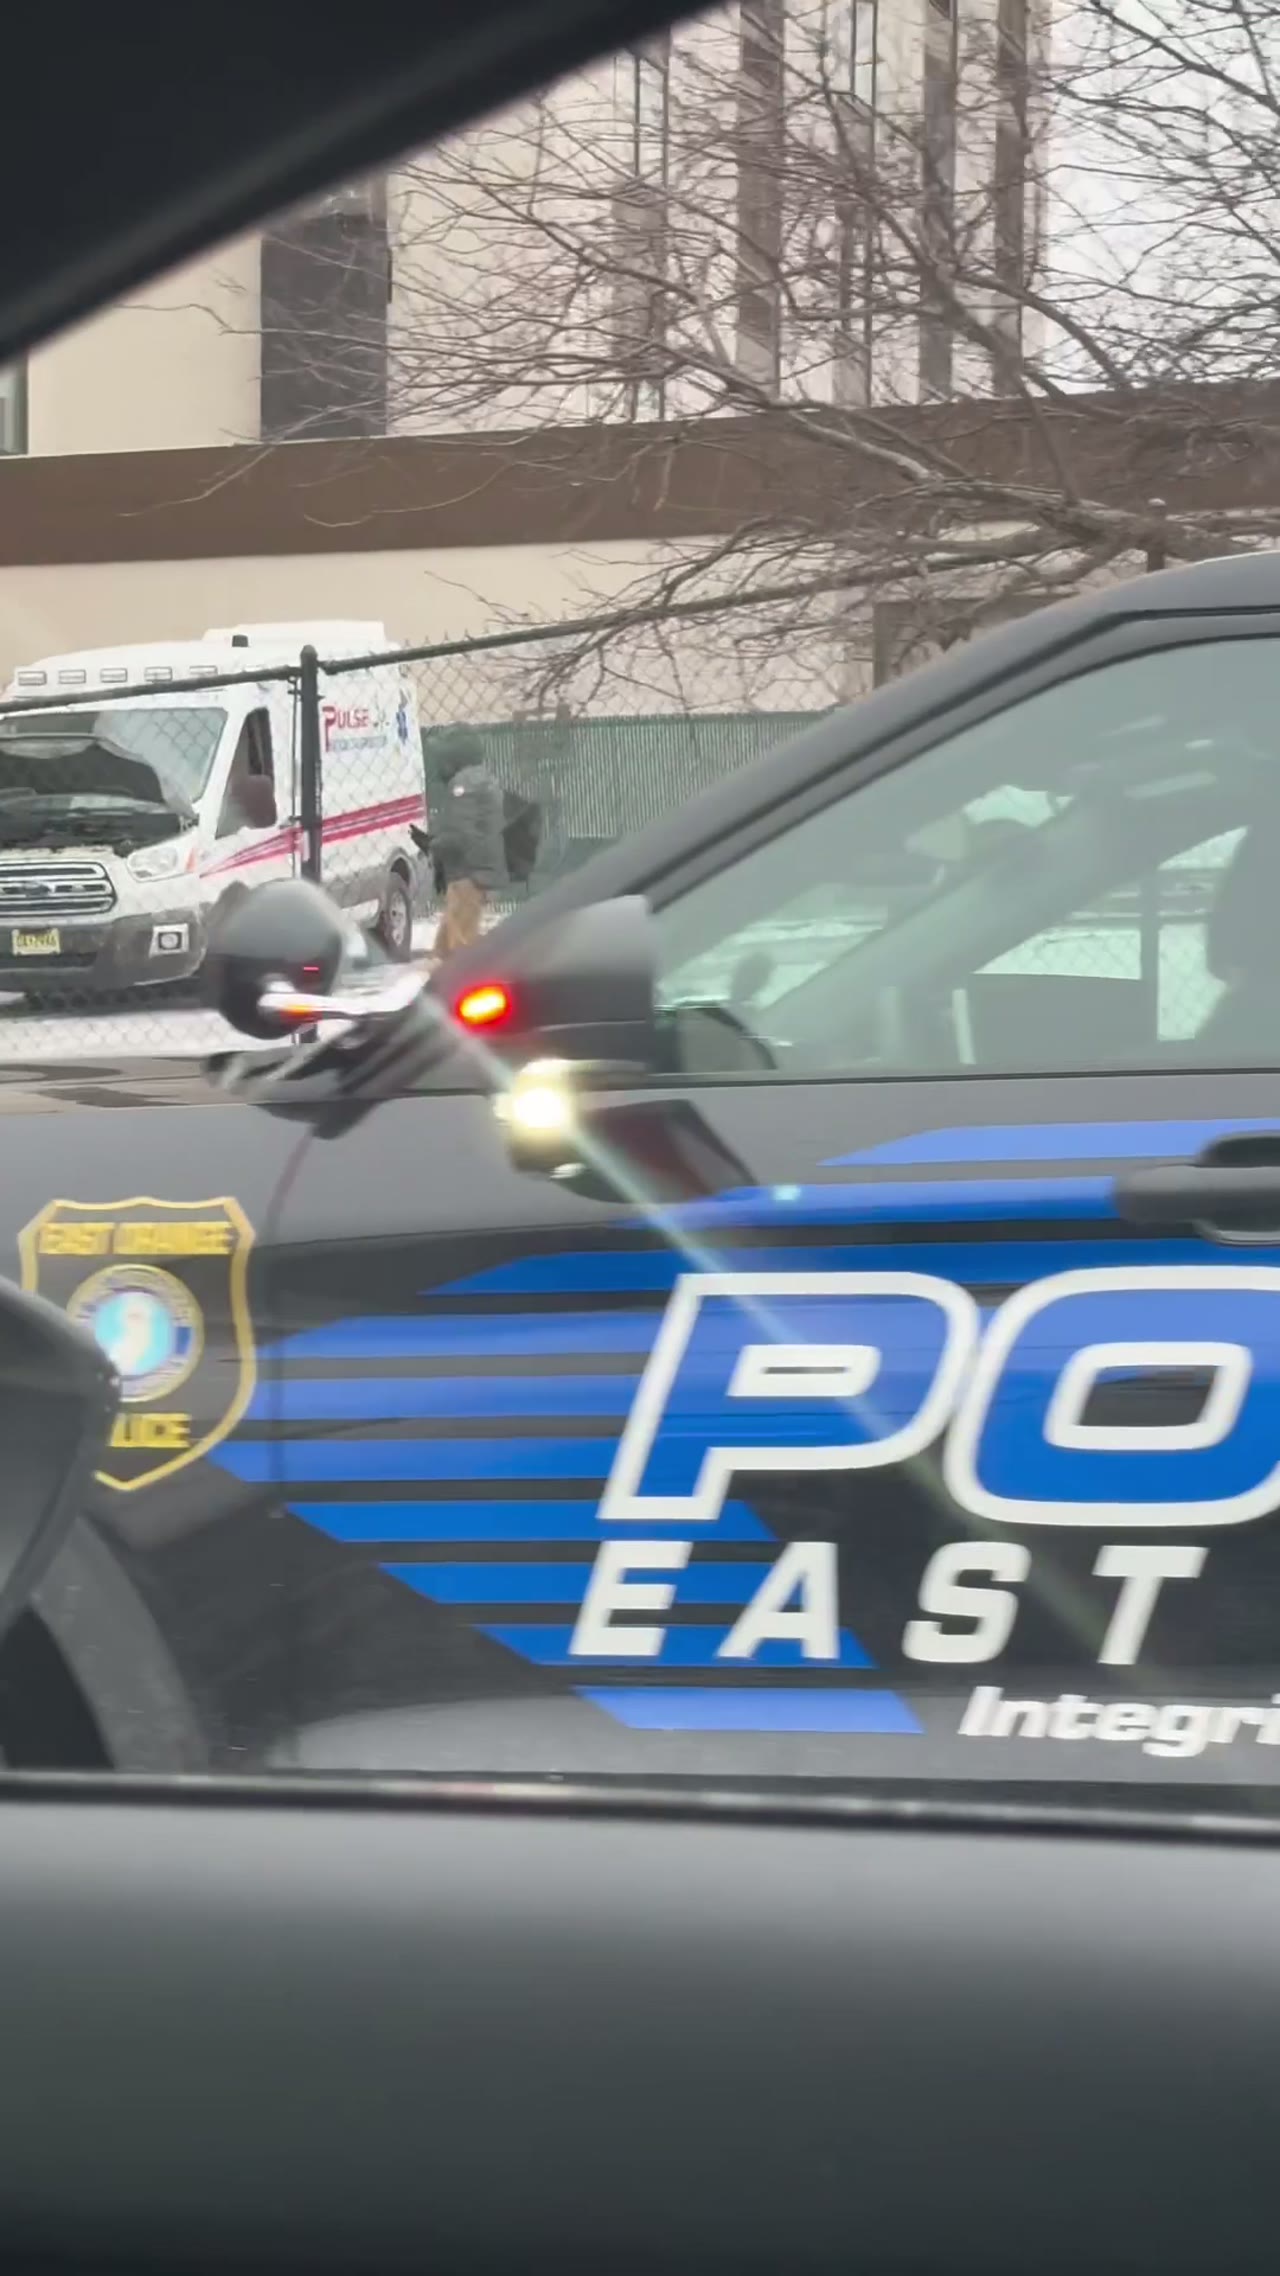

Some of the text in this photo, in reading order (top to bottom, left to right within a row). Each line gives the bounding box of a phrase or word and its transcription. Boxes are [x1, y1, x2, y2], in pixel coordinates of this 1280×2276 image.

[38, 1221, 230, 1256] EAST ORANGE
[110, 1412, 191, 1448] LICE
[596, 1265, 1280, 1527] PO
[568, 1540, 1208, 1665] EAST
